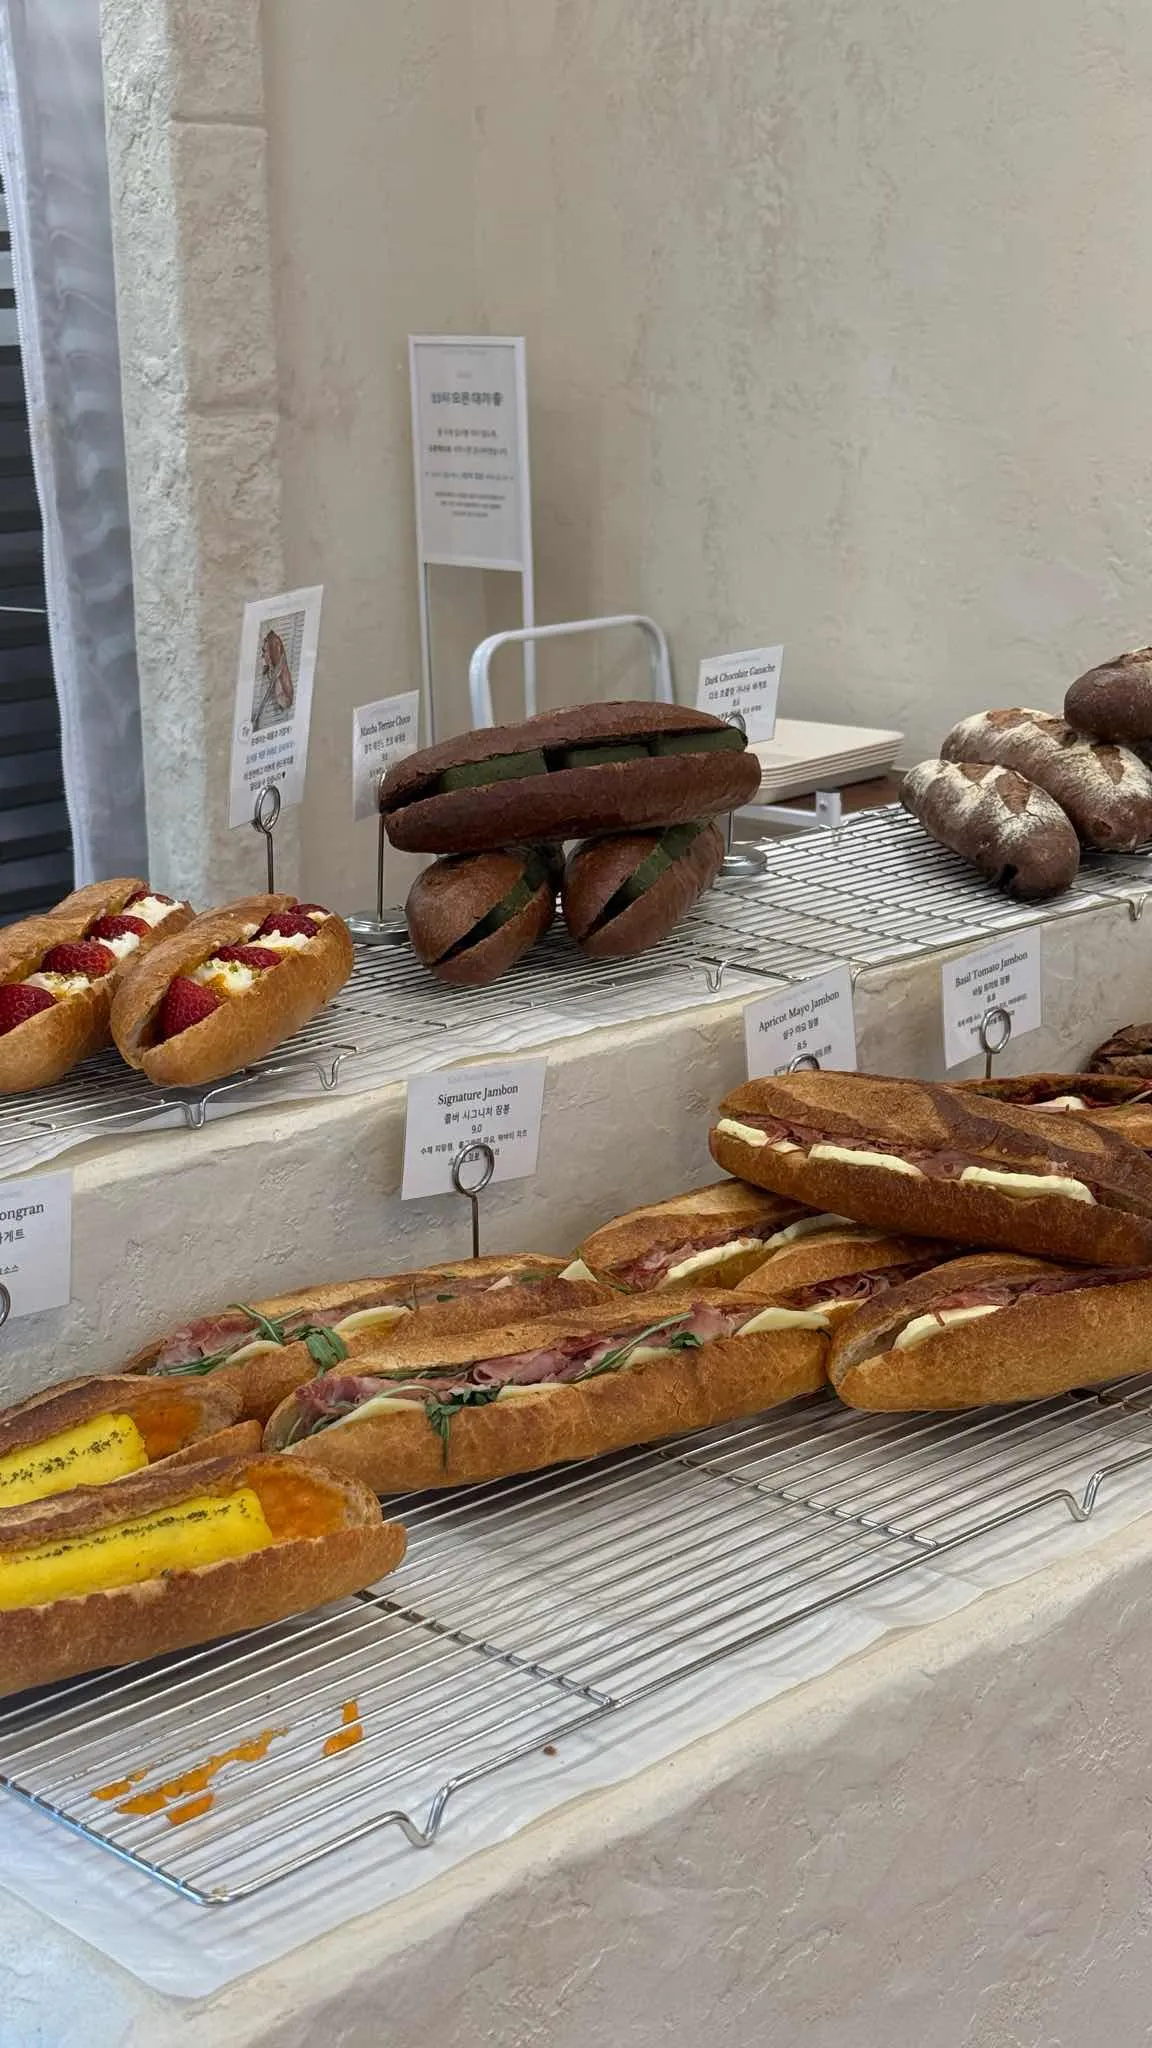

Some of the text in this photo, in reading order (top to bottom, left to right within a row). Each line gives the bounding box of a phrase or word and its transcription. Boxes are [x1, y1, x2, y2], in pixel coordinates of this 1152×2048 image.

[972, 961, 1000, 980] Tomato
[1000, 951, 1028, 972] Jambon
[758, 1013, 788, 1033] Apricot
[788, 1004, 811, 1019] Mayo
[810, 990, 840, 1012] Jambon
[437, 1084, 519, 1107] Signature Jambon
[462, 1105, 493, 1121] 시그니처
[495, 1103, 511, 1116] 잠봉
